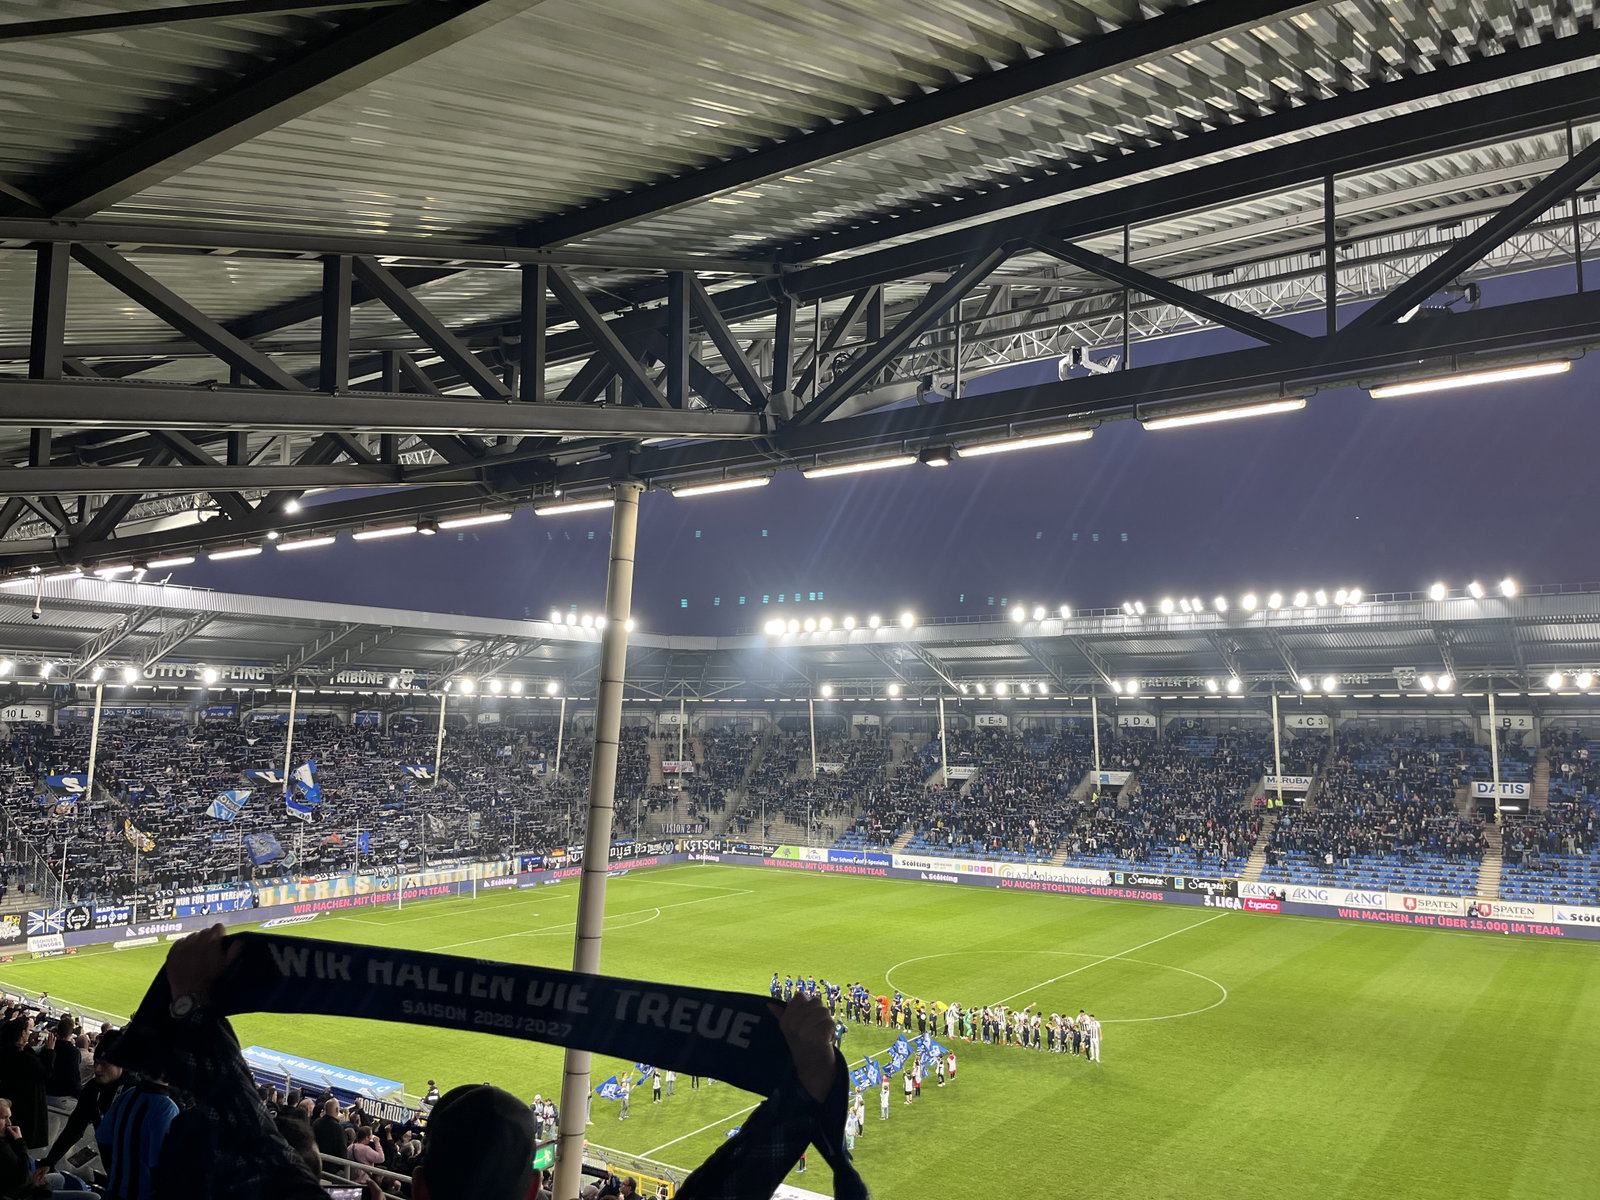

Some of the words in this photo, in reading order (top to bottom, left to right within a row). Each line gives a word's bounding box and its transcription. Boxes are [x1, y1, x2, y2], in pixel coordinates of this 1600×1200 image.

[6, 710, 16, 718] 10
[21, 709, 28, 719] L
[35, 710, 40, 718] 9
[1306, 718, 1314, 726] C
[1502, 718, 1512, 728] B
[1267, 776, 1309, 784] MRUBA
[662, 823, 685, 834] VISION
[684, 840, 720, 851] KETSCH
[818, 862, 834, 871] ÜBER
[902, 859, 931, 869] Stölting
[929, 873, 958, 883] Stölting
[1128, 873, 1164, 885] Scholz
[259, 876, 371, 907] ULTRAS
[1014, 881, 1040, 890] AUCH?
[1042, 883, 1164, 901] STOELTING-GRUPPE.DE/JOBS
[176, 896, 190, 906] NUR
[192, 894, 205, 904] FÜR
[294, 905, 312, 914] WIR
[313, 899, 352, 912] MACHEN.
[354, 897, 368, 906] MIT
[370, 893, 391, 904] ÜBER
[429, 886, 450, 895] TEAM.
[1204, 895, 1215, 906] 3.
[1216, 896, 1242, 910] LIGA
[1248, 900, 1278, 910] tipico
[1418, 899, 1458, 909] SPATEN
[1493, 905, 1535, 915] SPATEN
[1338, 908, 1358, 918] WIR
[1362, 911, 1412, 923] MACHEN.
[1414, 915, 1435, 925] MIT
[1438, 916, 1467, 928] ÜBER
[1470, 920, 1508, 931] 15.000
[1511, 923, 1525, 932] IM
[1528, 924, 1564, 936] TEAM.
[138, 922, 182, 936] Stölting
[268, 942, 351, 982] WIR
[614, 989, 761, 1049] TREUE
[402, 1000, 467, 1022] SAISON
